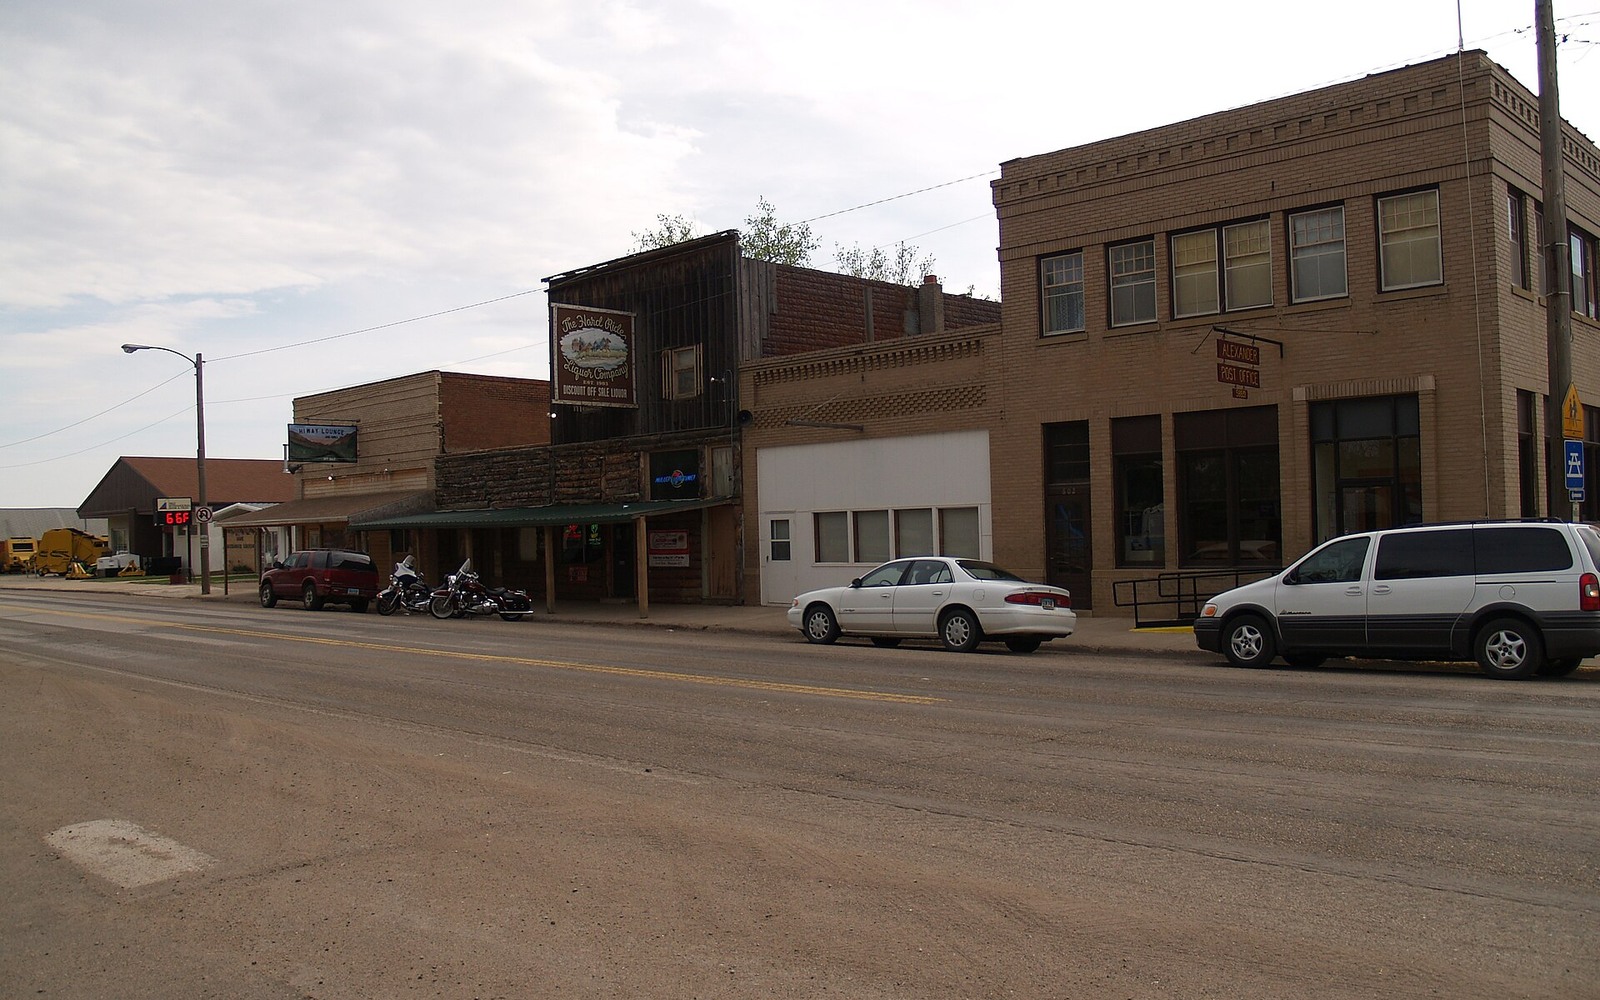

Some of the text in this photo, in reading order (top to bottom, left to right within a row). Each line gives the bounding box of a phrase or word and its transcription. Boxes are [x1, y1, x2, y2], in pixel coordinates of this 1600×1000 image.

[562, 316, 578, 333] The
[576, 314, 603, 328] Hard
[1222, 343, 1258, 362] ALEXANDER
[563, 356, 629, 382] Liquor Company
[1221, 366, 1259, 386] POST OFFICE
[563, 384, 628, 399] DISCOUNT OFF SALE LIQUOR
[321, 428, 345, 436] LOUNGE
